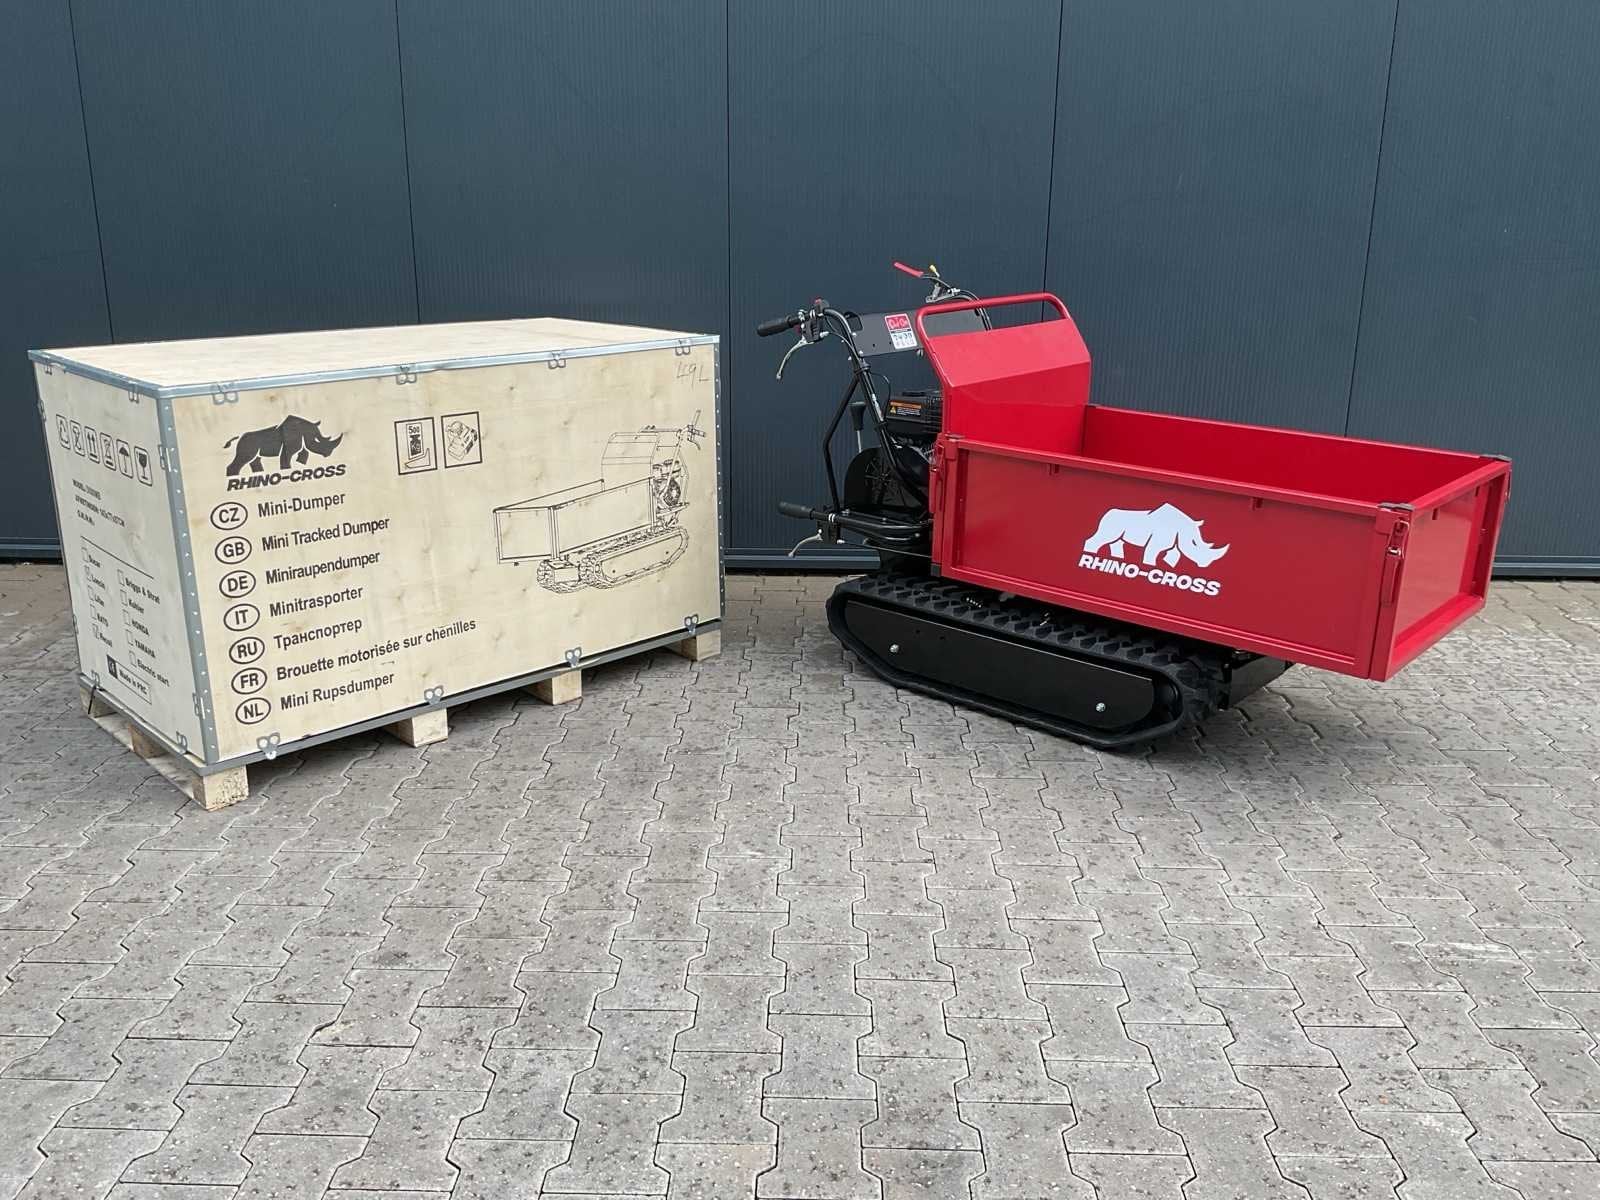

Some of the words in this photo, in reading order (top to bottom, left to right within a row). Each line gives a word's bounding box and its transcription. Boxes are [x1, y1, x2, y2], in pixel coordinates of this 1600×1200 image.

[227, 464, 347, 491] RHINO-CROSS
[218, 507, 241, 524] CZ
[258, 493, 346, 518] Mini-Dumper
[262, 534, 289, 552] Mini
[291, 525, 341, 546] Tracked
[343, 517, 390, 539] Dumper
[223, 541, 245, 558] GB
[266, 551, 381, 585] Miniraupendumper
[1079, 554, 1221, 596] RHINO-CROSS
[227, 576, 248, 592] DE
[269, 586, 364, 618] Minitrasporter
[234, 608, 249, 625] IT
[274, 618, 363, 650] Транспортер
[237, 641, 258, 658] RU
[276, 657, 335, 681] Brouette
[338, 639, 400, 667] motorisée
[403, 633, 424, 649] sur
[425, 618, 477, 644] chenilles
[239, 672, 260, 689] FR
[280, 691, 309, 711] Mini
[313, 673, 395, 701] Rupsdumper
[243, 702, 264, 719] NL
